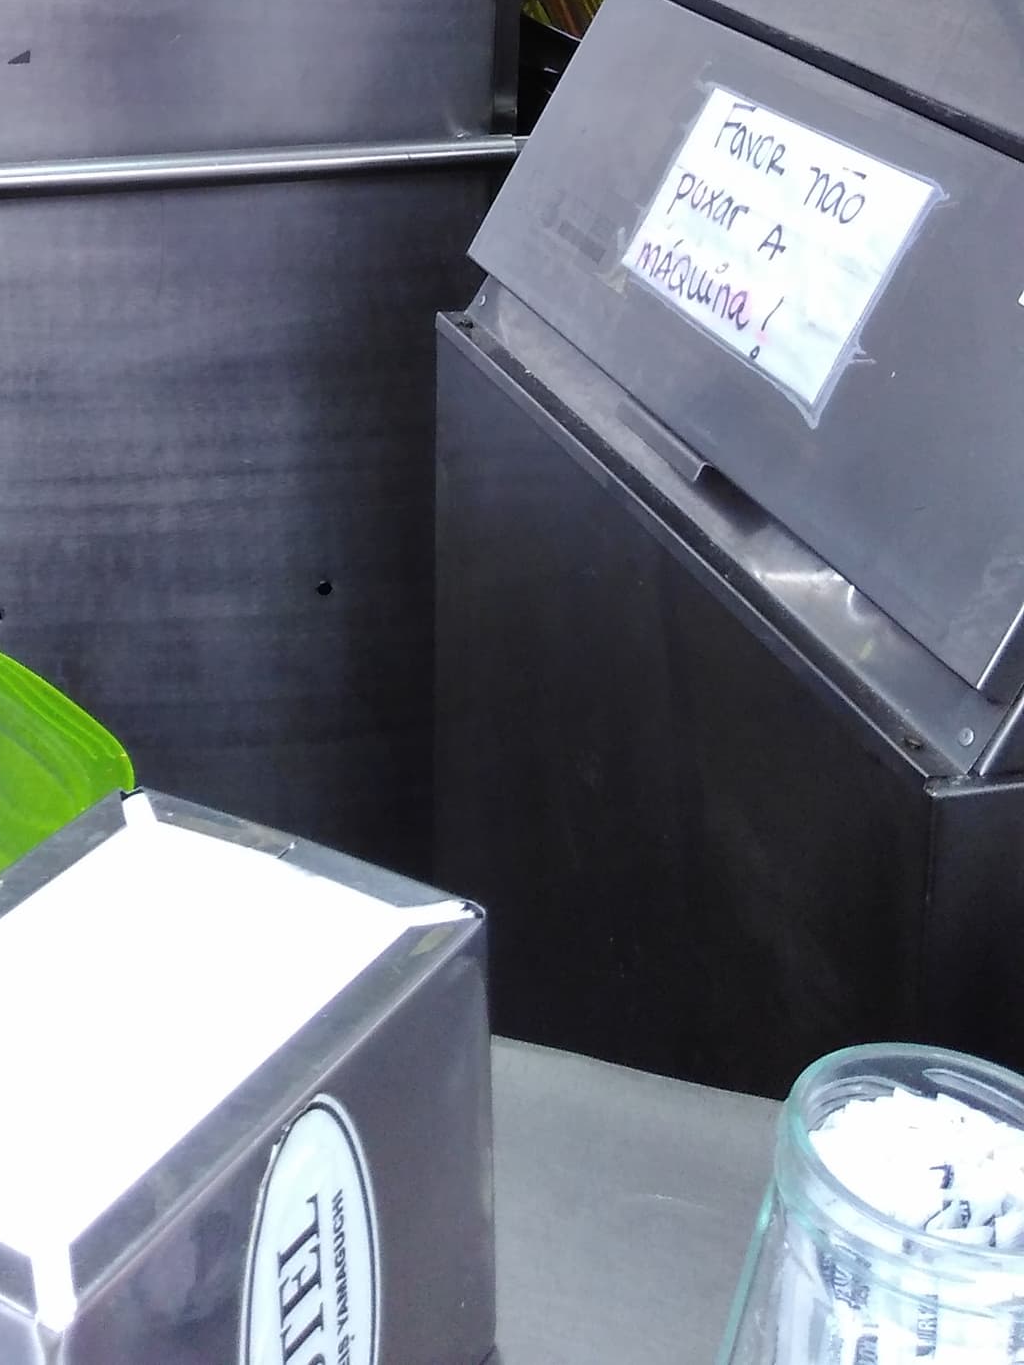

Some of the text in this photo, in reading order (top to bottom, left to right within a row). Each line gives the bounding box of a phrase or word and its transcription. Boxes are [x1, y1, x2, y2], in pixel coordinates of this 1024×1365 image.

[757, 225, 786, 260] A
[277, 1193, 326, 1365] TEL
[332, 1189, 349, 1336] YAMAGUCHI
